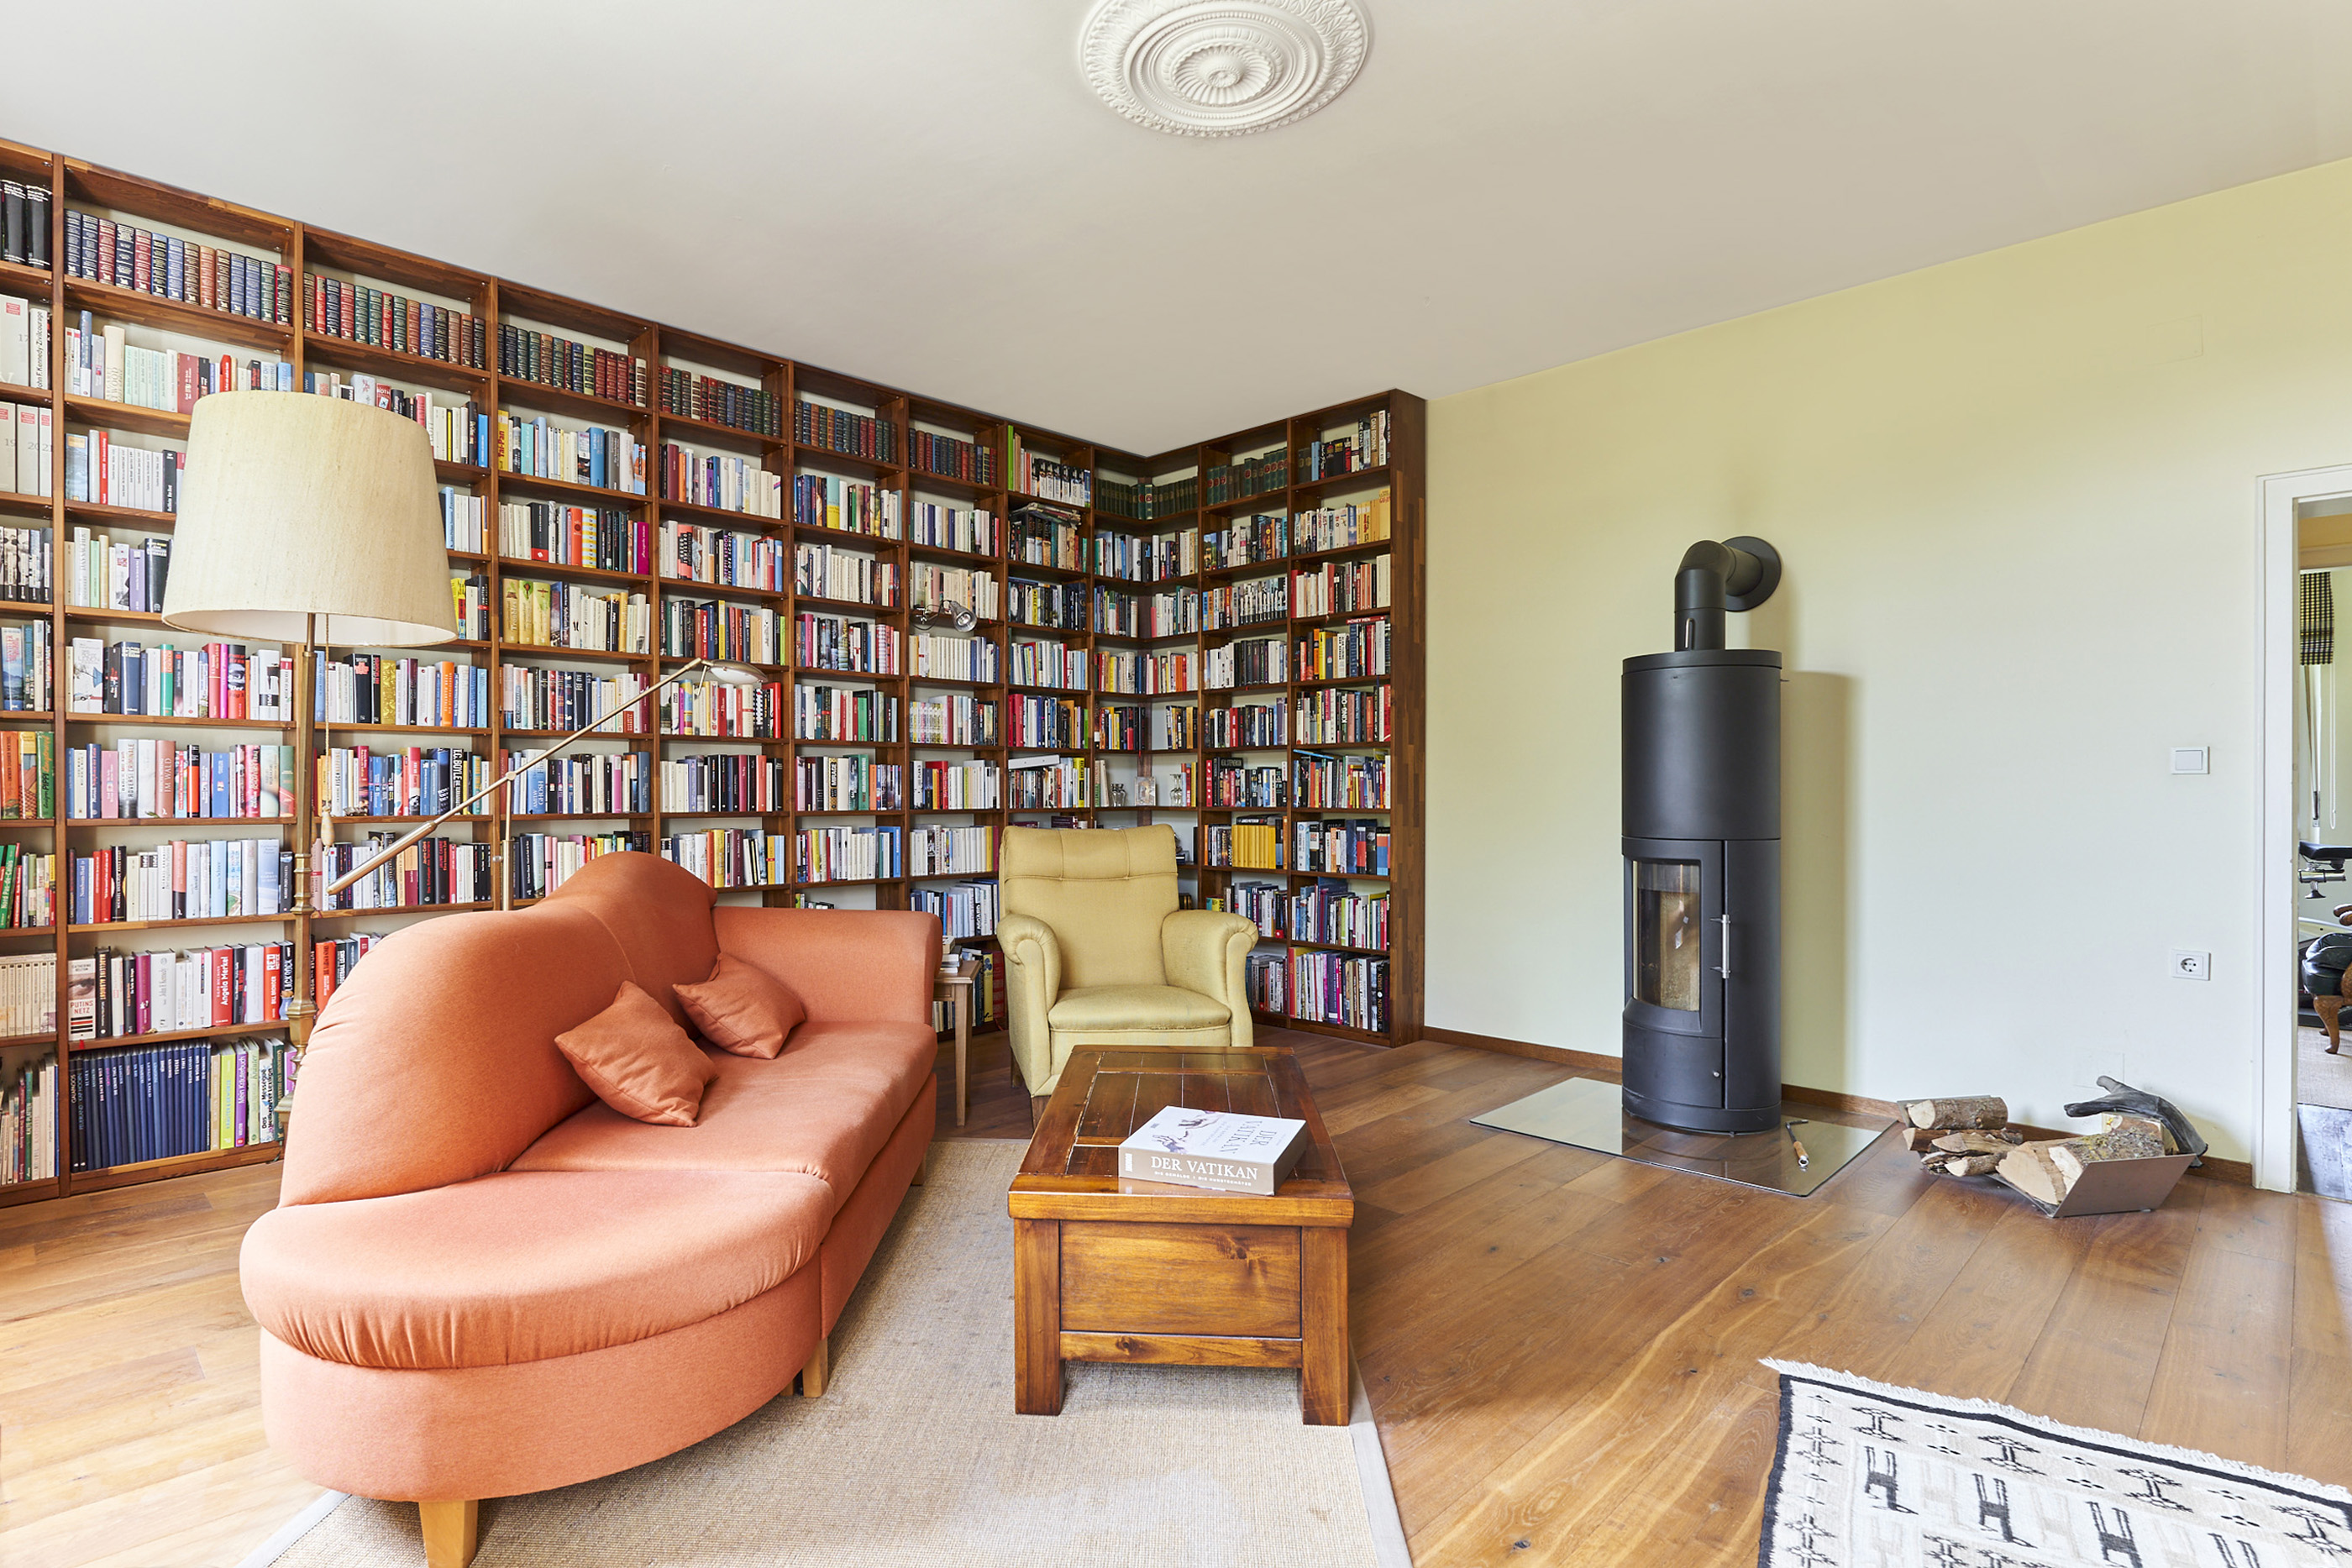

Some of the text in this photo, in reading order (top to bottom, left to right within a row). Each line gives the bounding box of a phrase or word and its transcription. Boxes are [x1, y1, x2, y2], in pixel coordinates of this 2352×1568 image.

[41, 735, 52, 774] Langstrumpf
[41, 773, 50, 791] PIPPI
[164, 757, 172, 793] IM WALD
[453, 760, 463, 781] BOYLE
[3, 860, 13, 895] Pas-de-Calais
[70, 1000, 93, 1009] PUTINS
[238, 1056, 246, 1089] Kräuterbuch
[1219, 1120, 1263, 1154] VATIKAN
[1250, 1130, 1278, 1146] DER
[1151, 1156, 1183, 1172] DER
[1186, 1160, 1258, 1181] VATIKAN
